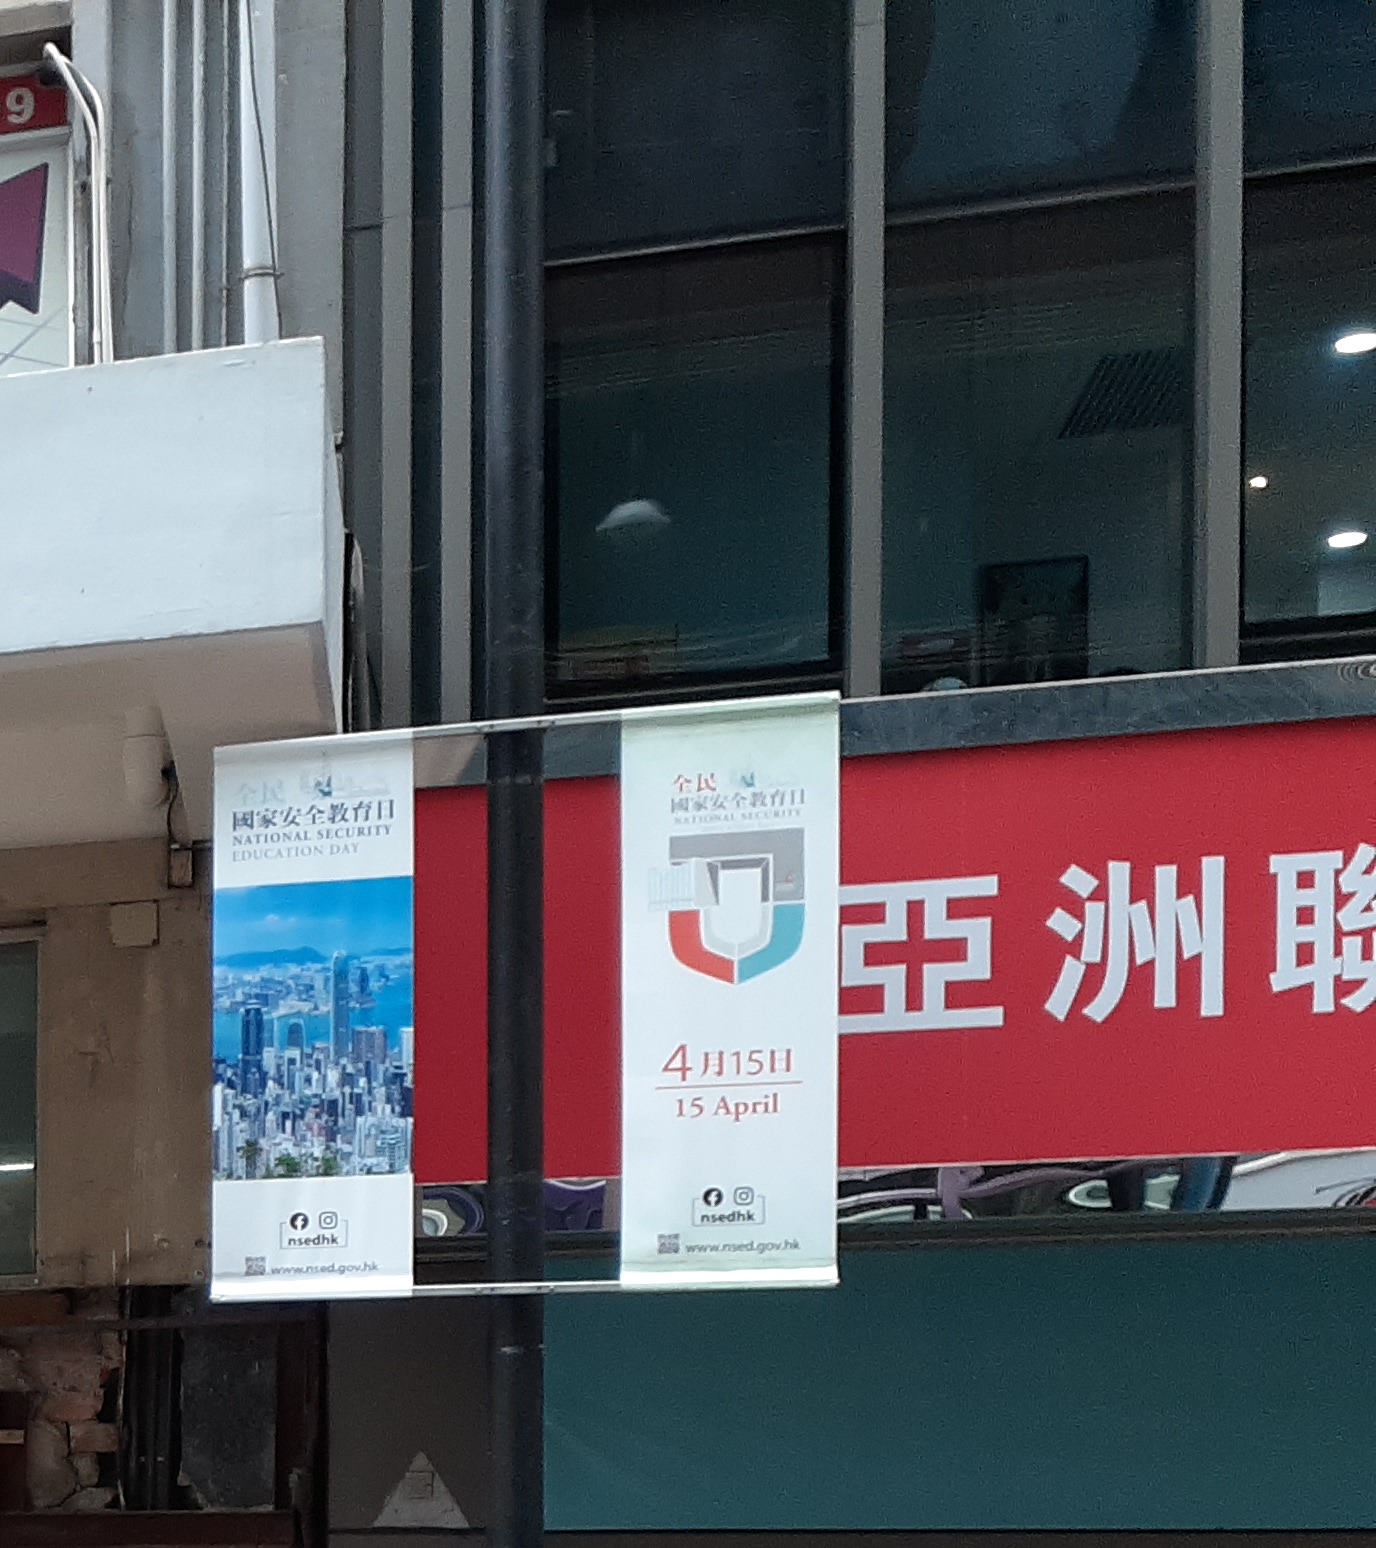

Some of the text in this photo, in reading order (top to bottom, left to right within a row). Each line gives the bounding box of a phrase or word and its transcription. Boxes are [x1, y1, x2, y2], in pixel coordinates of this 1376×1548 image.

[232, 799, 394, 831] 國家安全教育日
[232, 825, 392, 846] NATIONAL SECURITY
[232, 843, 360, 862] EDUCATION DAY
[677, 1093, 778, 1122] 15 April
[701, 1210, 755, 1223] nsedhk
[288, 1234, 338, 1246] nsedhk
[686, 1239, 799, 1254] www.nsed.gov.hk
[271, 1262, 379, 1276] www.nsed.gov.hk
